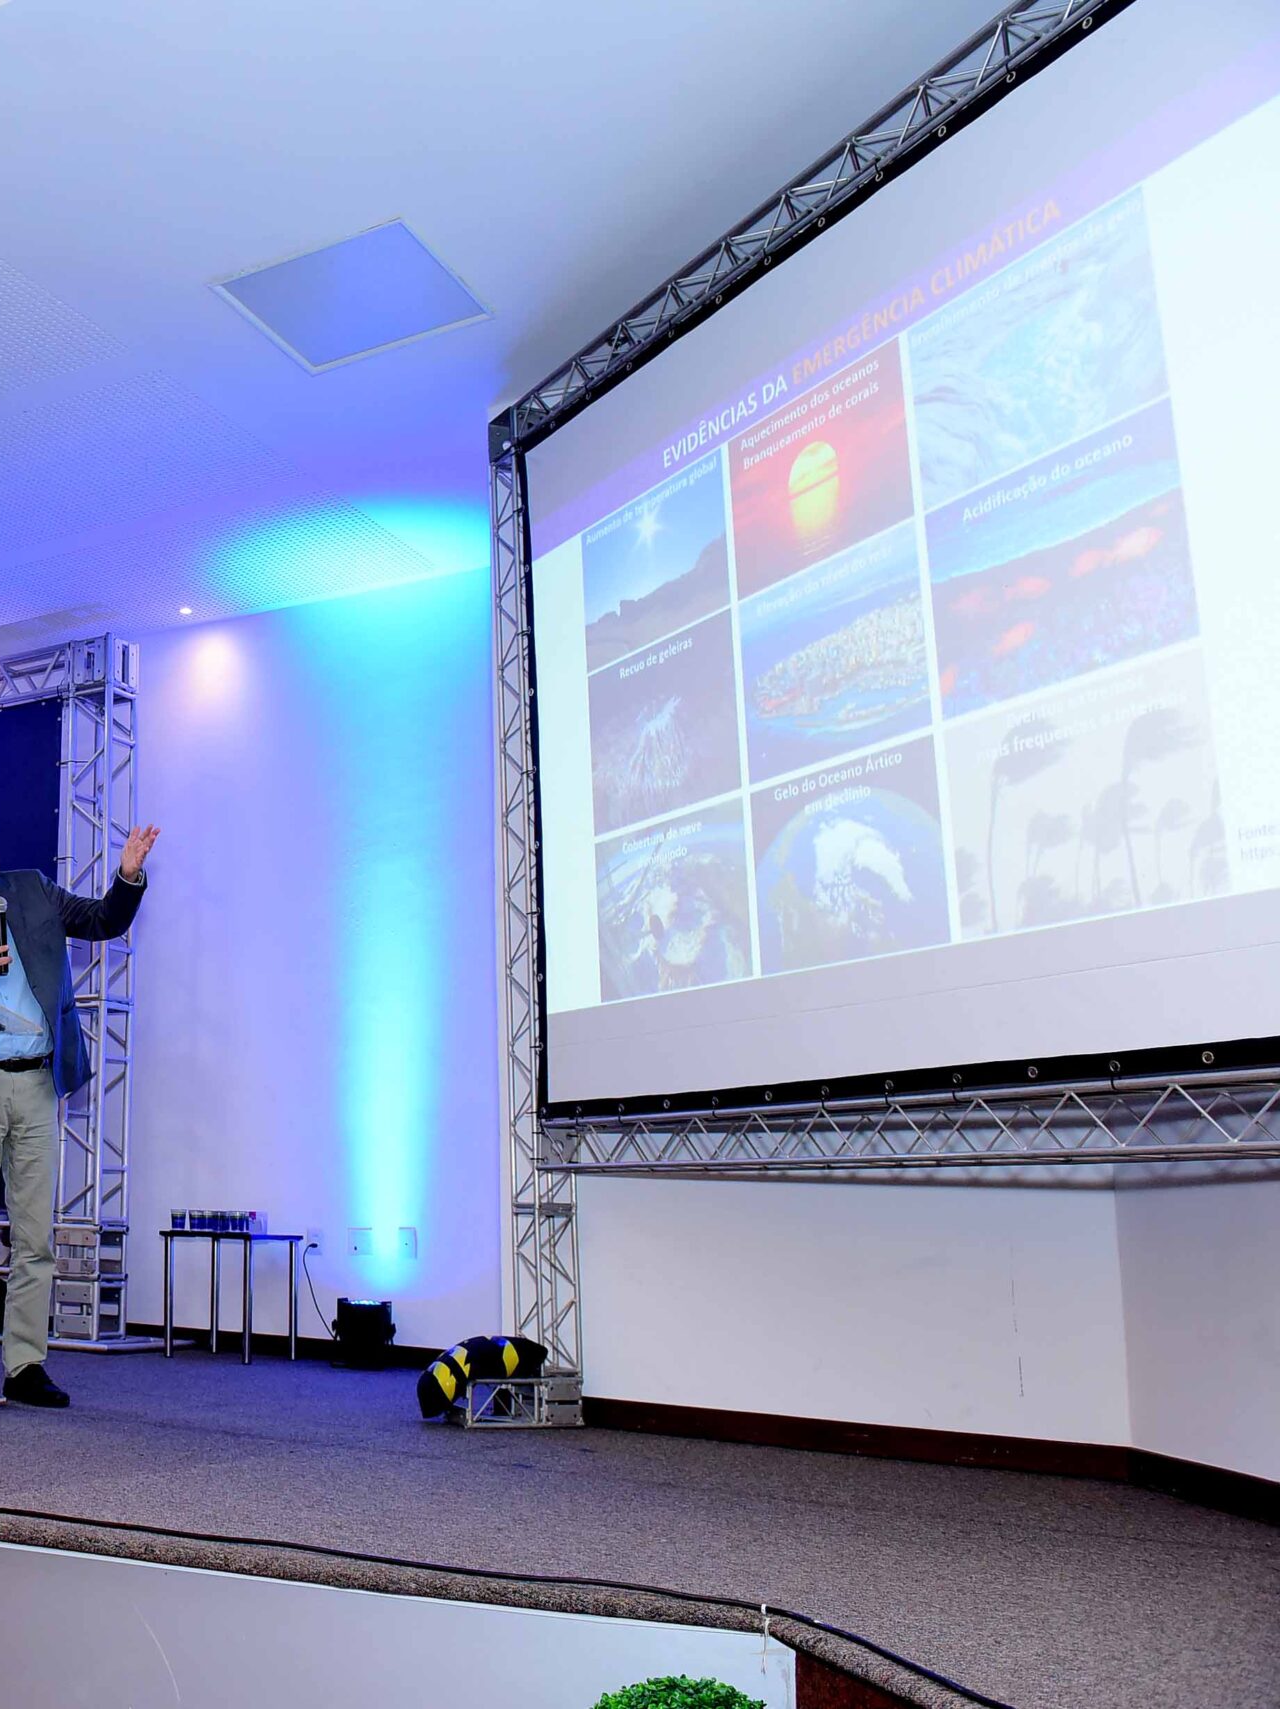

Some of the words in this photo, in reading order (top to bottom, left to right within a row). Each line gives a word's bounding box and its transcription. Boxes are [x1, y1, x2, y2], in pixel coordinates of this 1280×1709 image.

[663, 392, 758, 468] EVIDÊNCIAS
[762, 374, 788, 404] DA
[791, 287, 925, 385] EMERGÊNCIA
[929, 199, 1061, 295] CLIMÁTICA
[740, 403, 807, 451] Aquecimento
[810, 390, 830, 408] dos
[832, 360, 879, 395] oceanos
[743, 414, 826, 470] Branqueamento
[828, 403, 842, 419] de
[845, 381, 879, 409] corais
[586, 517, 622, 546] Aumento
[622, 509, 633, 523] de
[689, 456, 717, 486] global
[963, 473, 1047, 522] Acidificação
[1050, 463, 1071, 481] do
[1074, 434, 1133, 470] oceano
[619, 661, 645, 680] Recuo
[646, 652, 657, 667] de
[659, 637, 693, 664] geleiras
[774, 784, 799, 802] Gelo
[802, 778, 816, 793] do
[818, 765, 863, 788] Oceano
[865, 752, 903, 774] Ártico
[804, 800, 823, 815] em
[622, 832, 665, 854] Cobertura
[666, 826, 677, 840] de
[678, 821, 703, 837] neve
